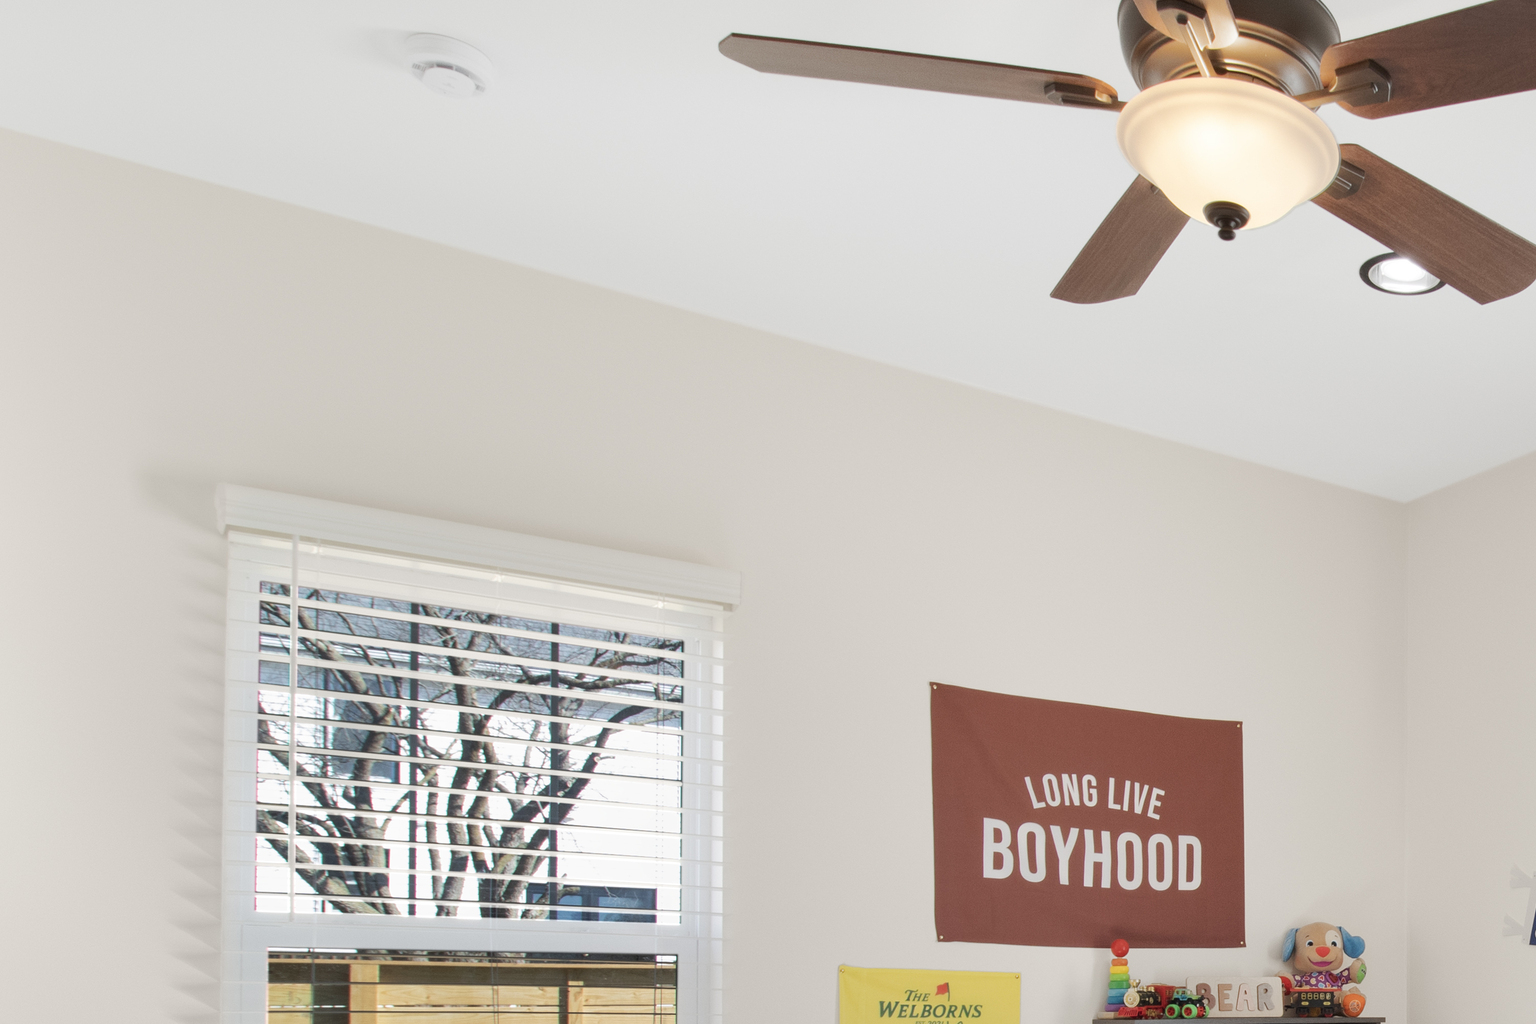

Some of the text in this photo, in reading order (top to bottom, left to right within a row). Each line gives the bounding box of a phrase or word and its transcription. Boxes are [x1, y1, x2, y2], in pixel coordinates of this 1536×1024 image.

[1024, 773, 1166, 820] LONG LIVE
[983, 817, 1202, 891] BOYHOOD
[879, 1001, 983, 1018] WELBORNS
[904, 989, 930, 1002] THE
[1196, 982, 1275, 1012] BEAR
